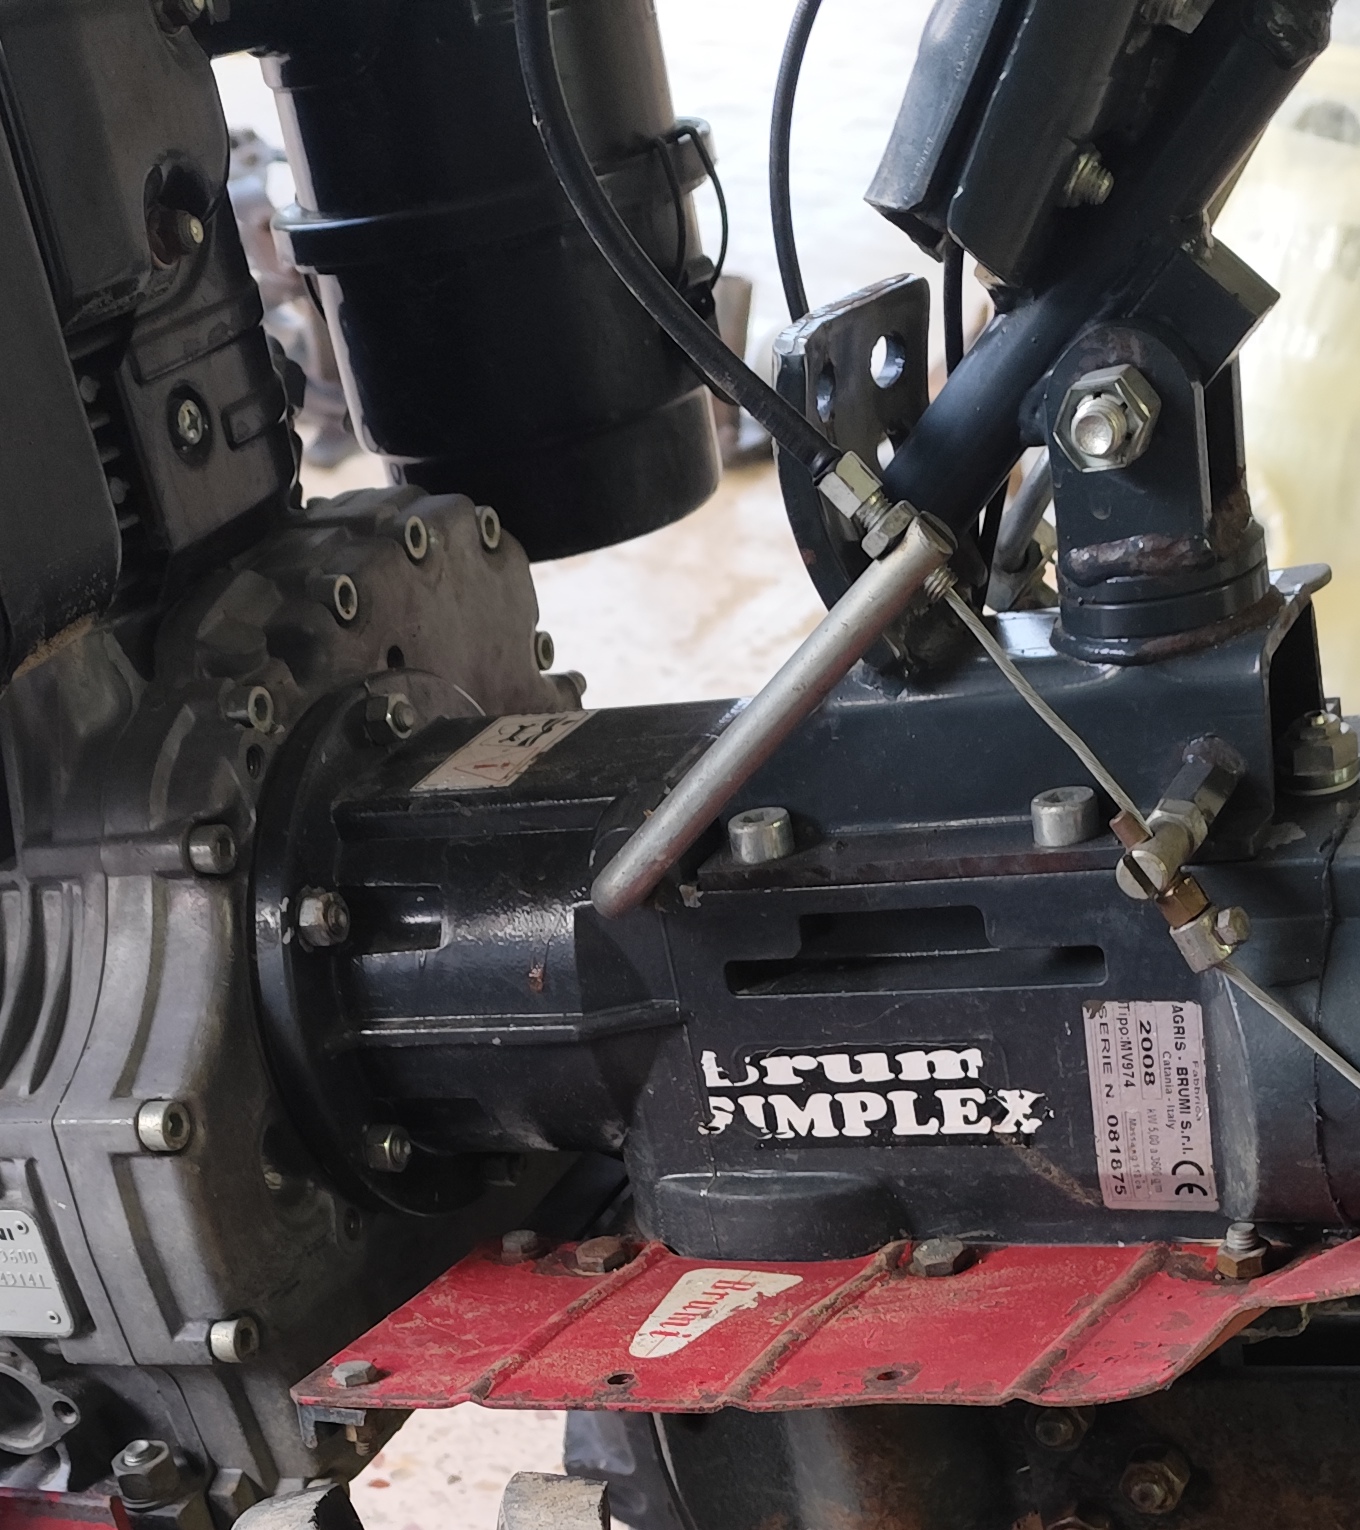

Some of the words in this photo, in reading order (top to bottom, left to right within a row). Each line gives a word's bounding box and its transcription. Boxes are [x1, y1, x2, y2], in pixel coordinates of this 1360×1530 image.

[1172, 1004, 1186, 1052] AGRIS
[1140, 1019, 1156, 1086] 2008
[1162, 1051, 1174, 1095] Catania
[1099, 1005, 1113, 1075] SERIE
[1106, 1114, 1127, 1195] 081875
[1176, 1066, 1191, 1115] BRUMI
[1166, 1105, 1177, 1130] Italy
[1181, 1120, 1193, 1155] S.r.l.
[649, 1279, 757, 1339] Brumi
